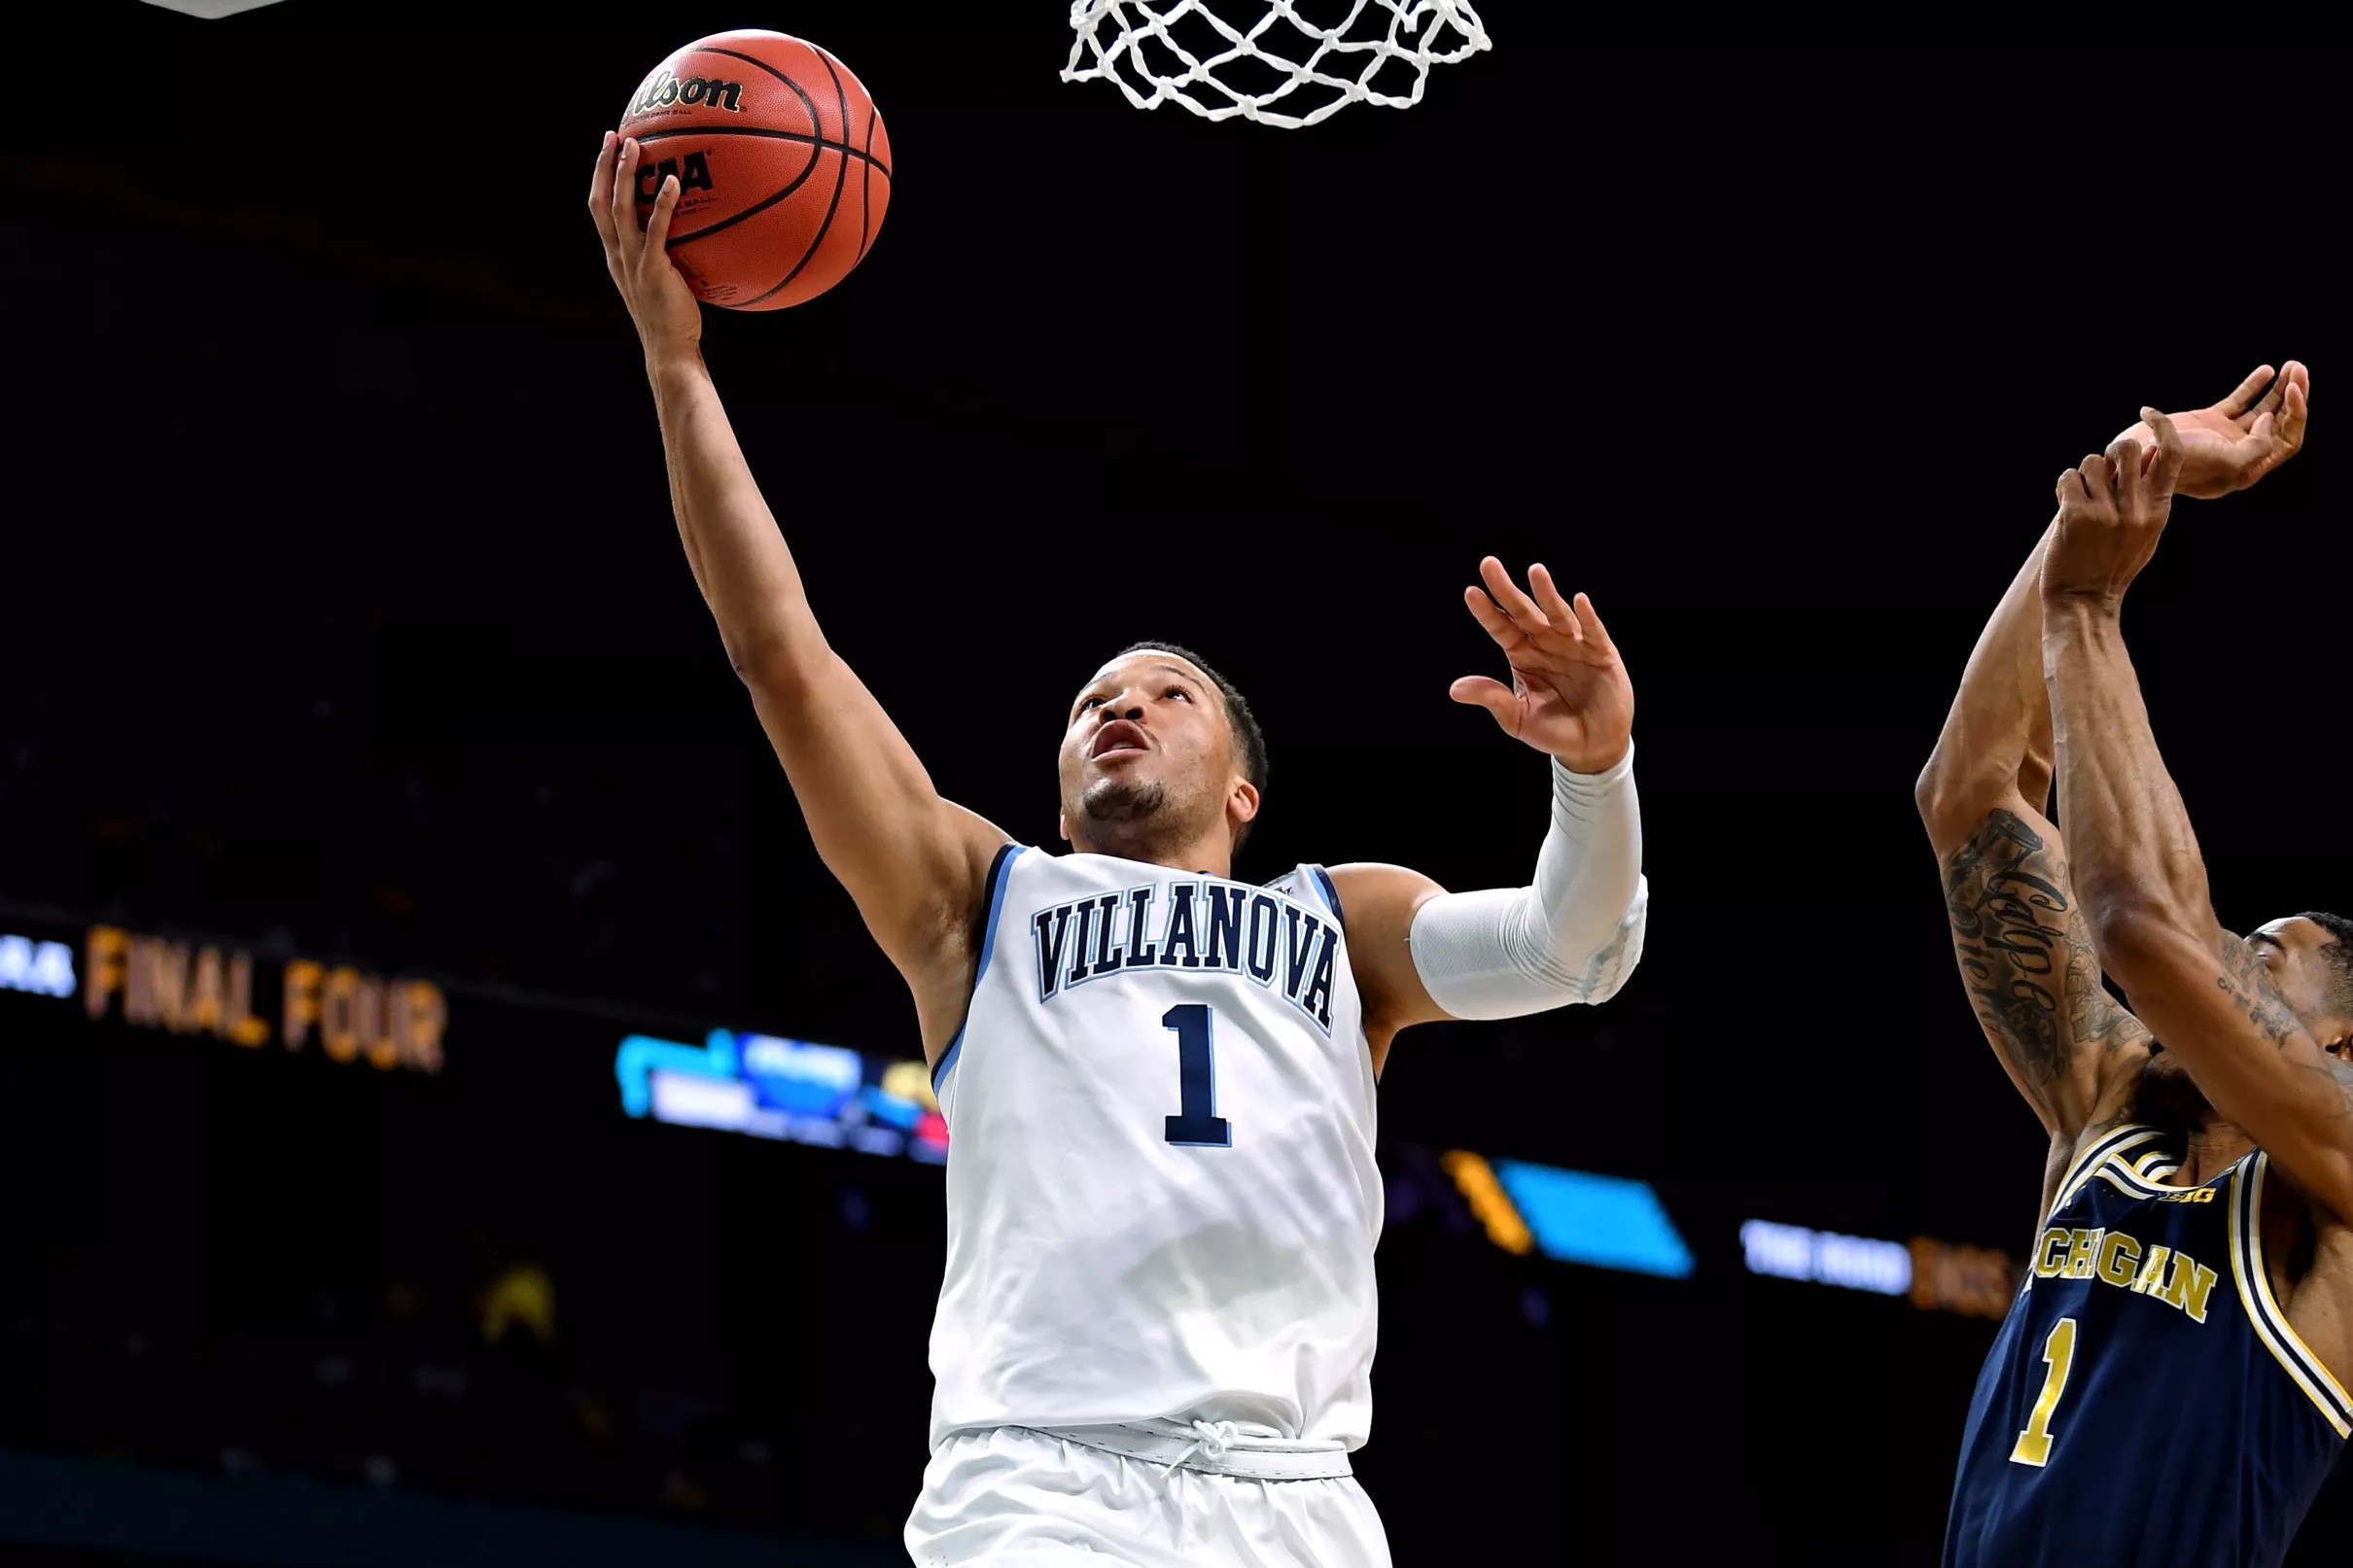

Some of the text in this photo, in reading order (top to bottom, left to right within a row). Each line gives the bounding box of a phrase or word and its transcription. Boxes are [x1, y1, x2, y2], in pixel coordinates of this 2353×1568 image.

[634, 150, 714, 205] CAA
[85, 924, 270, 1048] FINAL
[283, 958, 448, 1075] FOUR
[1031, 881, 1342, 1039] VILLANOVA
[1162, 1004, 1232, 1147] 1
[2032, 1227, 2218, 1324] CHGAN
[2009, 1317, 2077, 1467] 1
